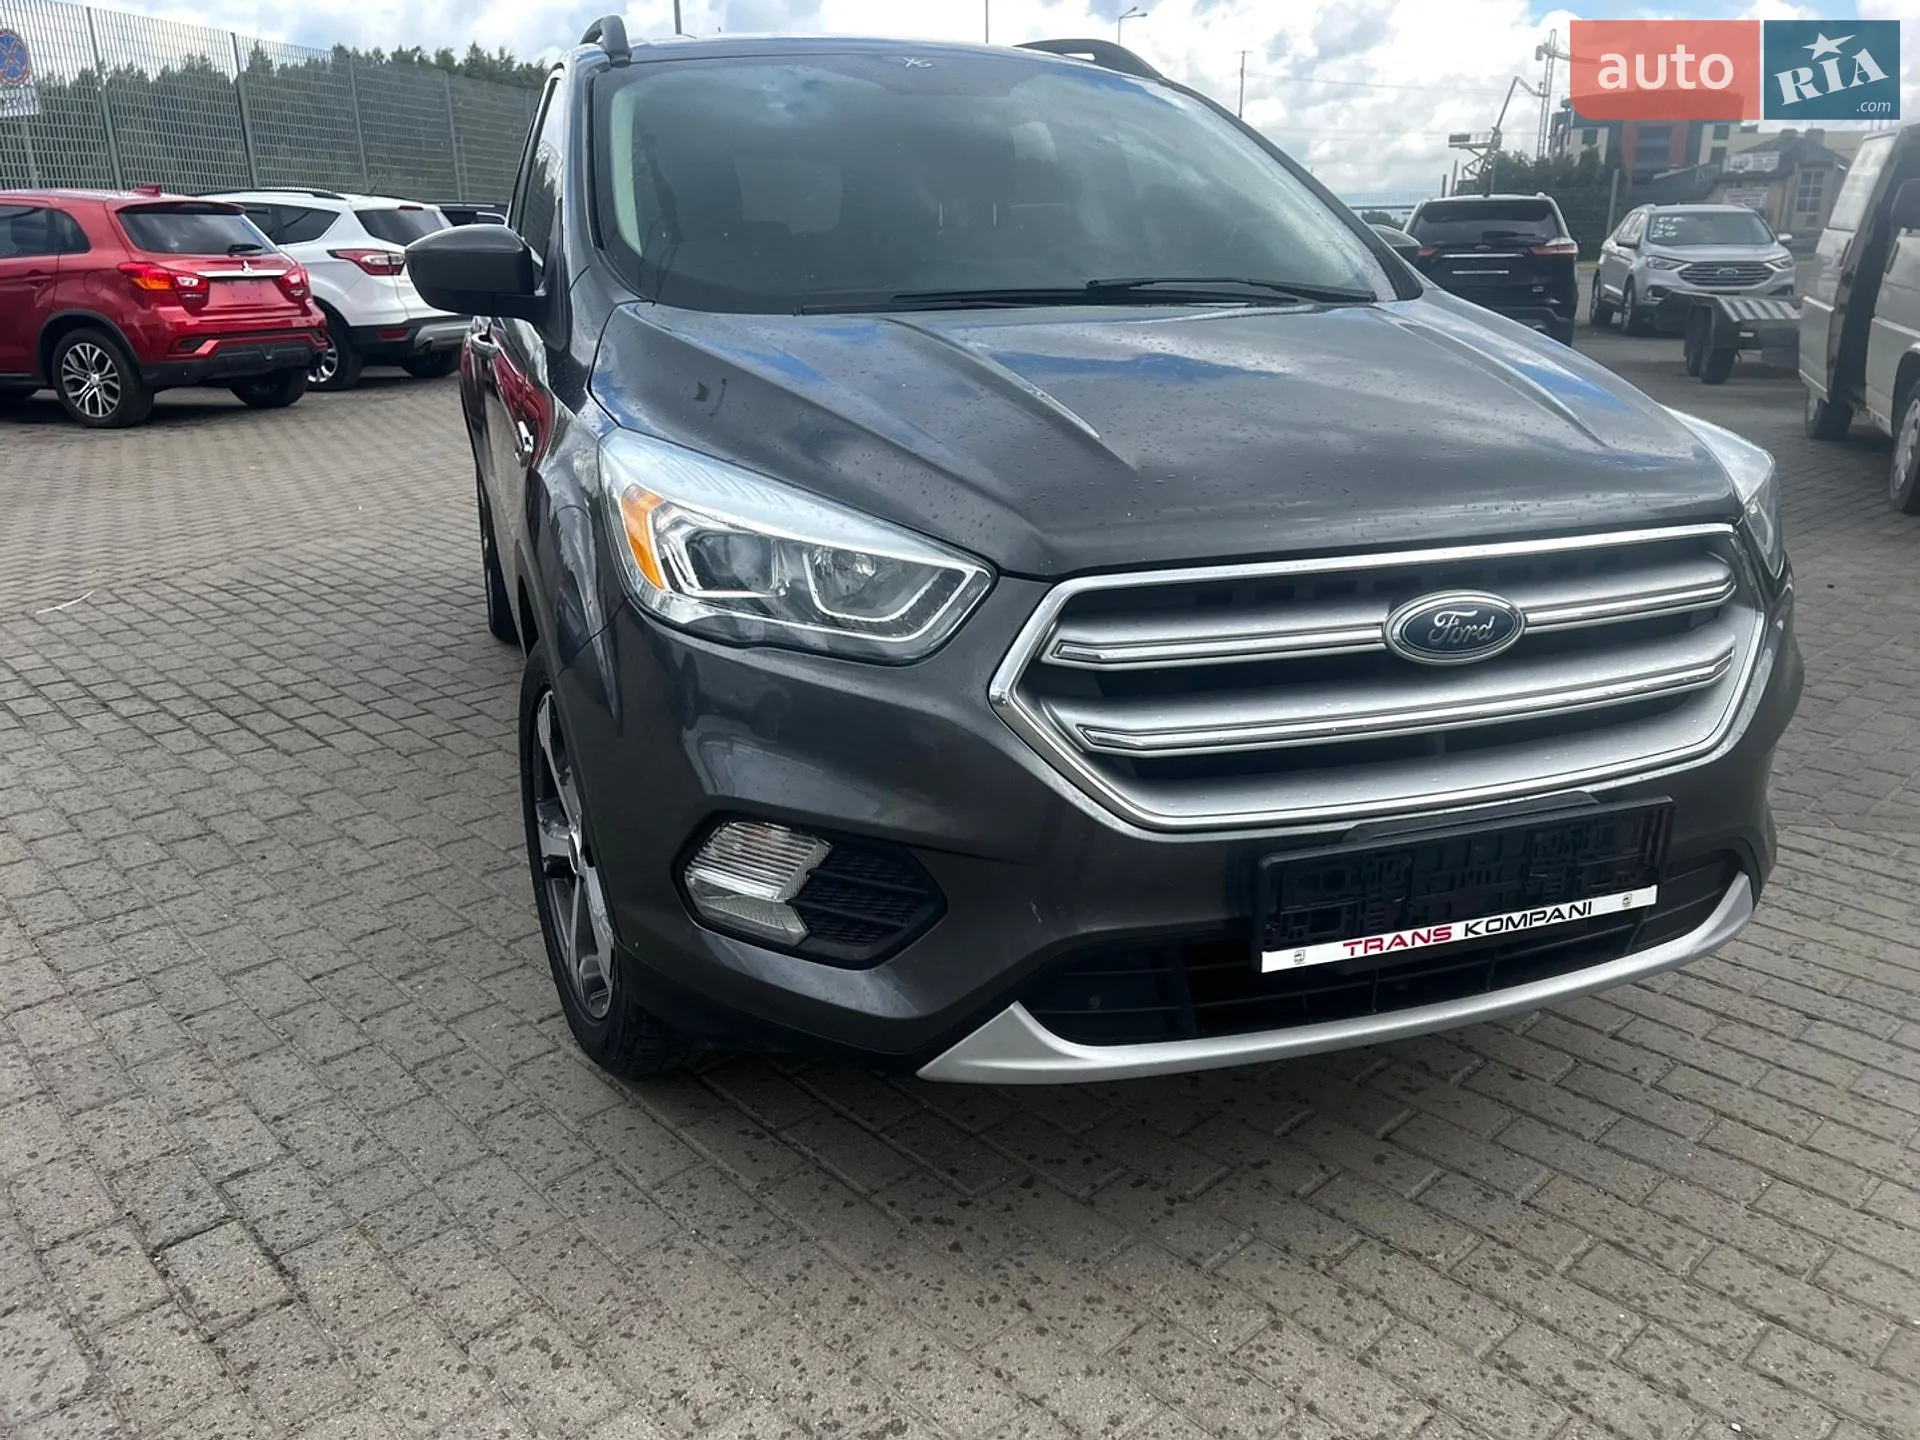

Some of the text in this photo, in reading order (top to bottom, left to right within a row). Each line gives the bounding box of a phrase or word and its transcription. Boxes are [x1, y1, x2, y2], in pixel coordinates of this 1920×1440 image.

[1427, 609, 1496, 646] Ford
[1343, 901, 1592, 956] TRANS KOMPANI
